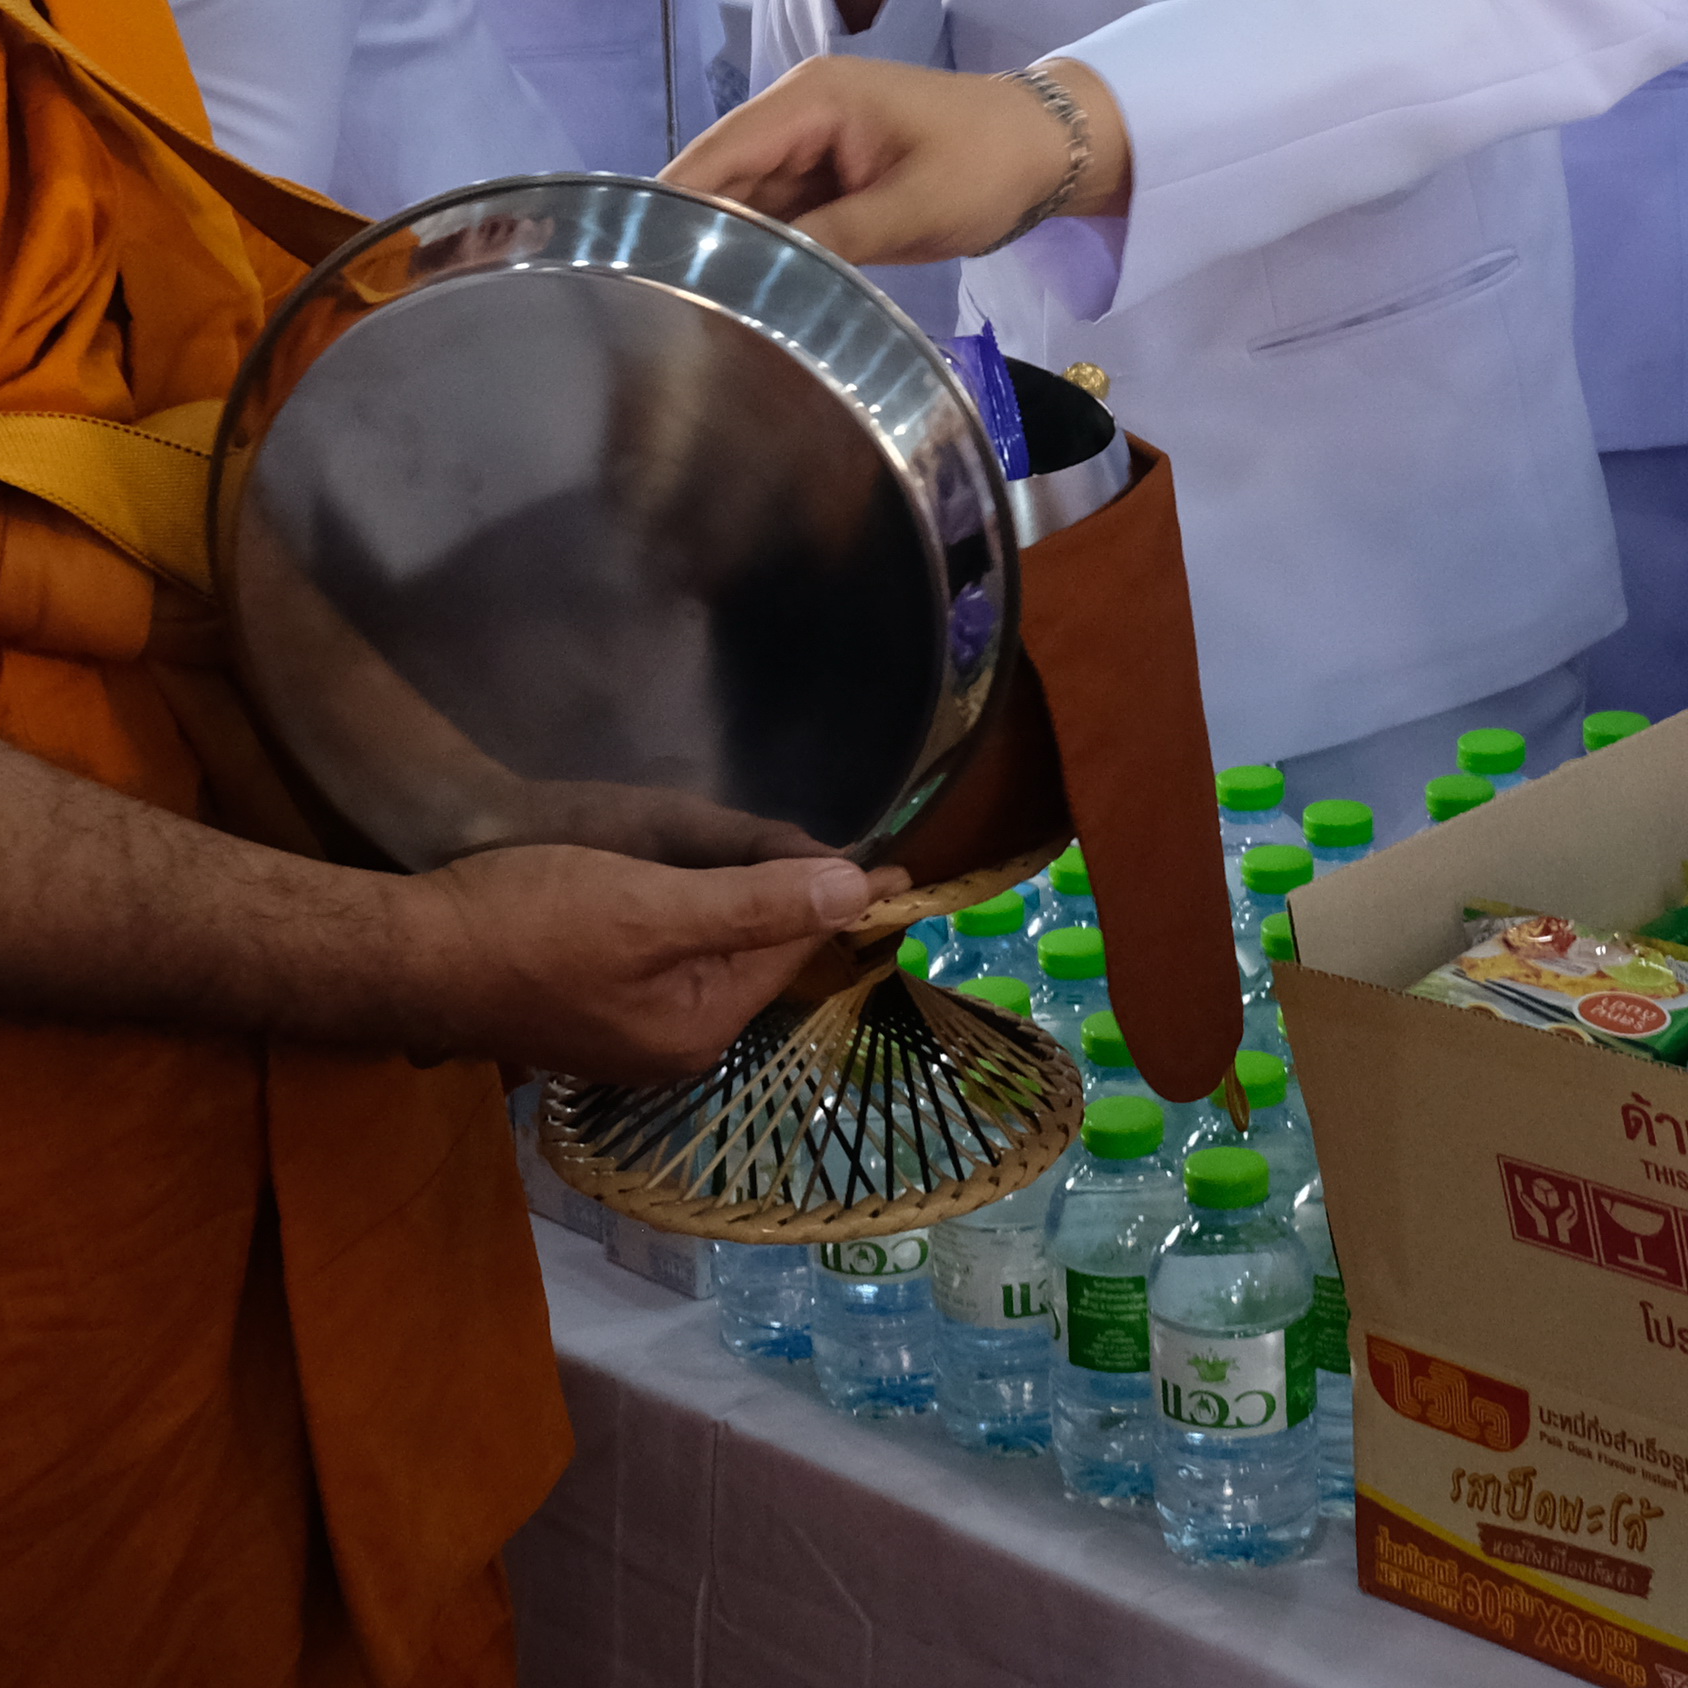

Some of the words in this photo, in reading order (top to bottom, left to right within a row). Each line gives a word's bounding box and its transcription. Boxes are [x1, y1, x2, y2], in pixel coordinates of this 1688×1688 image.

[1370, 1340, 1512, 1452] ไวไว
[1641, 1466, 1678, 1491] Instant
[1449, 1464, 1665, 1553] รสเป็ดพะโล้
[1461, 1572, 1502, 1630] 60
[1602, 1650, 1648, 1688] bags
